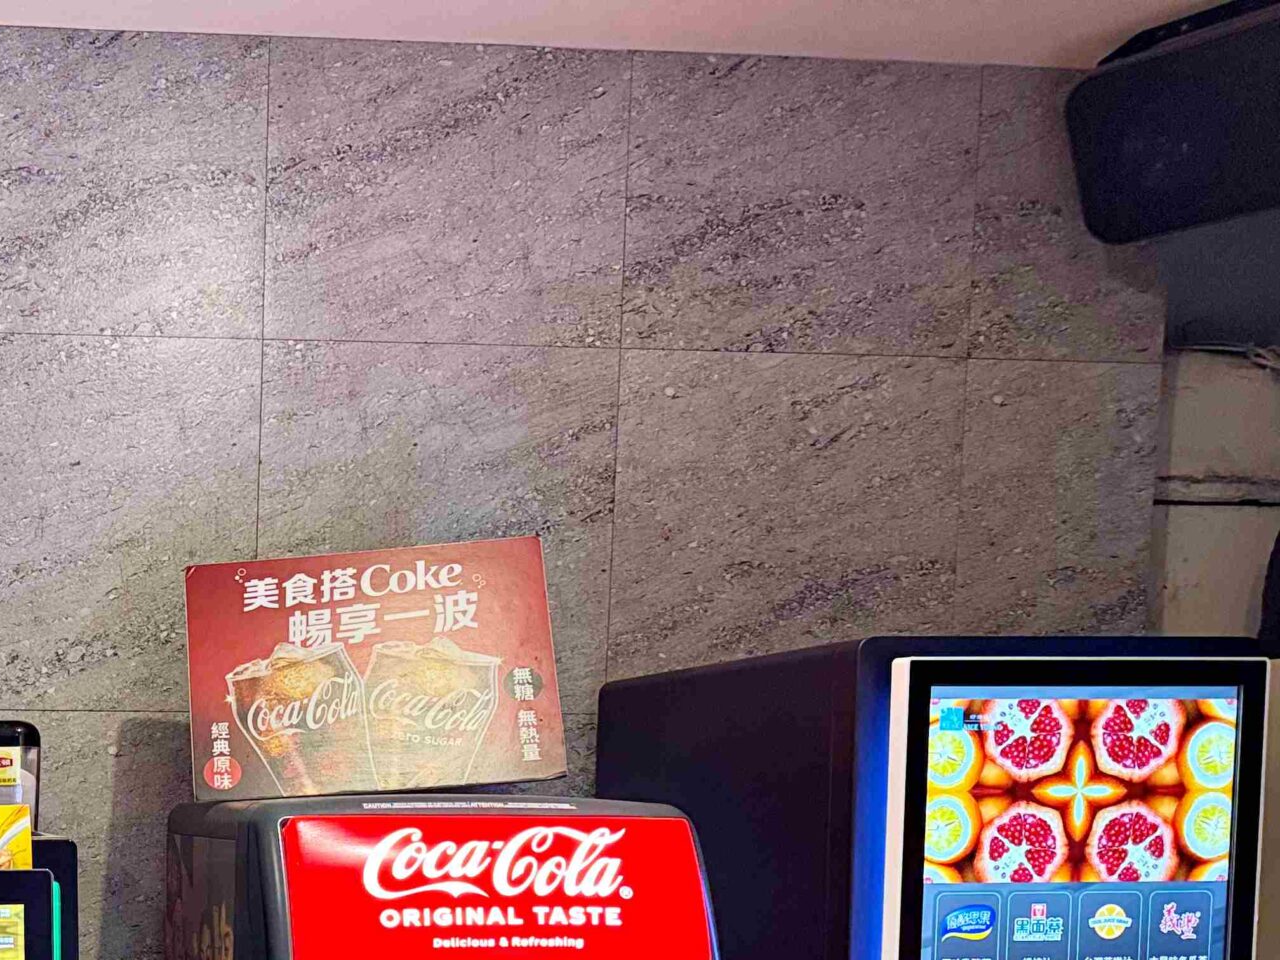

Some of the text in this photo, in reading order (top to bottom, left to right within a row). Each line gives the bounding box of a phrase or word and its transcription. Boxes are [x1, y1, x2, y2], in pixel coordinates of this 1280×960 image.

[288, 590, 478, 649] 暢享一波
[247, 672, 361, 741] Coca-Cola
[369, 679, 494, 732] Coca-Cola
[513, 667, 542, 763] 無糖 無熱量
[211, 722, 233, 789] 經典原味
[362, 827, 627, 899] Coca-Cola
[379, 905, 623, 928] ORIGINAL TASTE
[432, 936, 584, 950] Delicious & Refreshing
